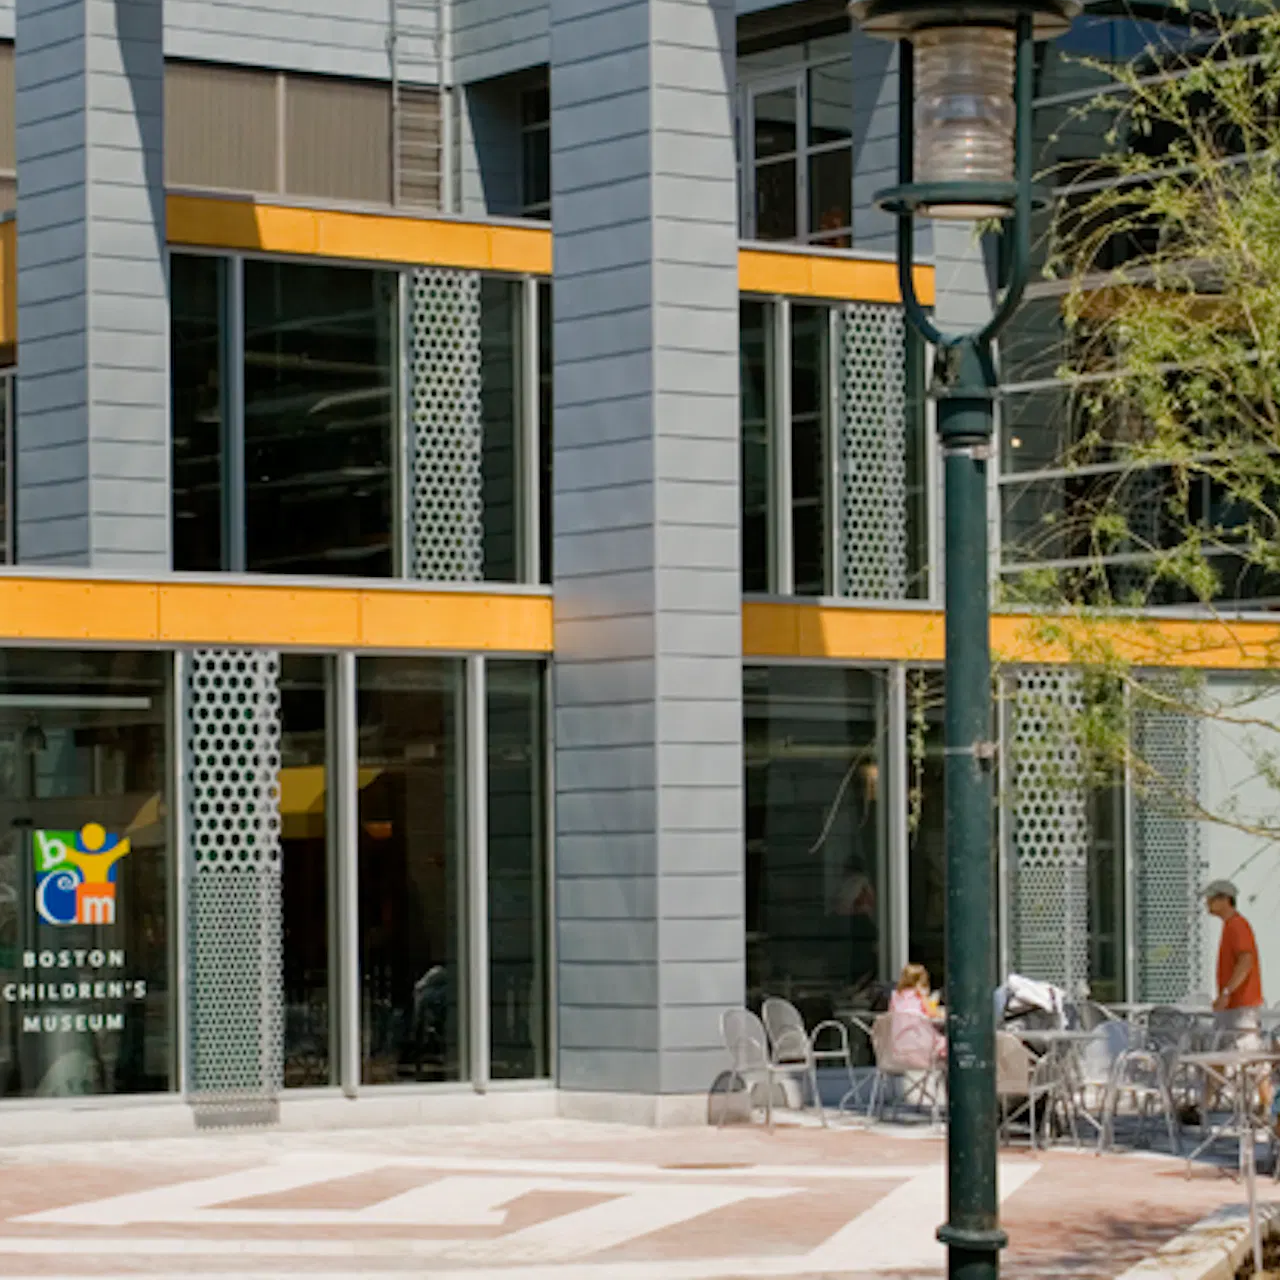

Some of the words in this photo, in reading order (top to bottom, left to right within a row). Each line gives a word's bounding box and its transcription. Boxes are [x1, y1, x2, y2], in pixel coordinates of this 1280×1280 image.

[23, 950, 124, 968] BOSTON
[3, 981, 147, 1001] CHILDREN'S
[23, 1015, 124, 1032] MUSEUM
